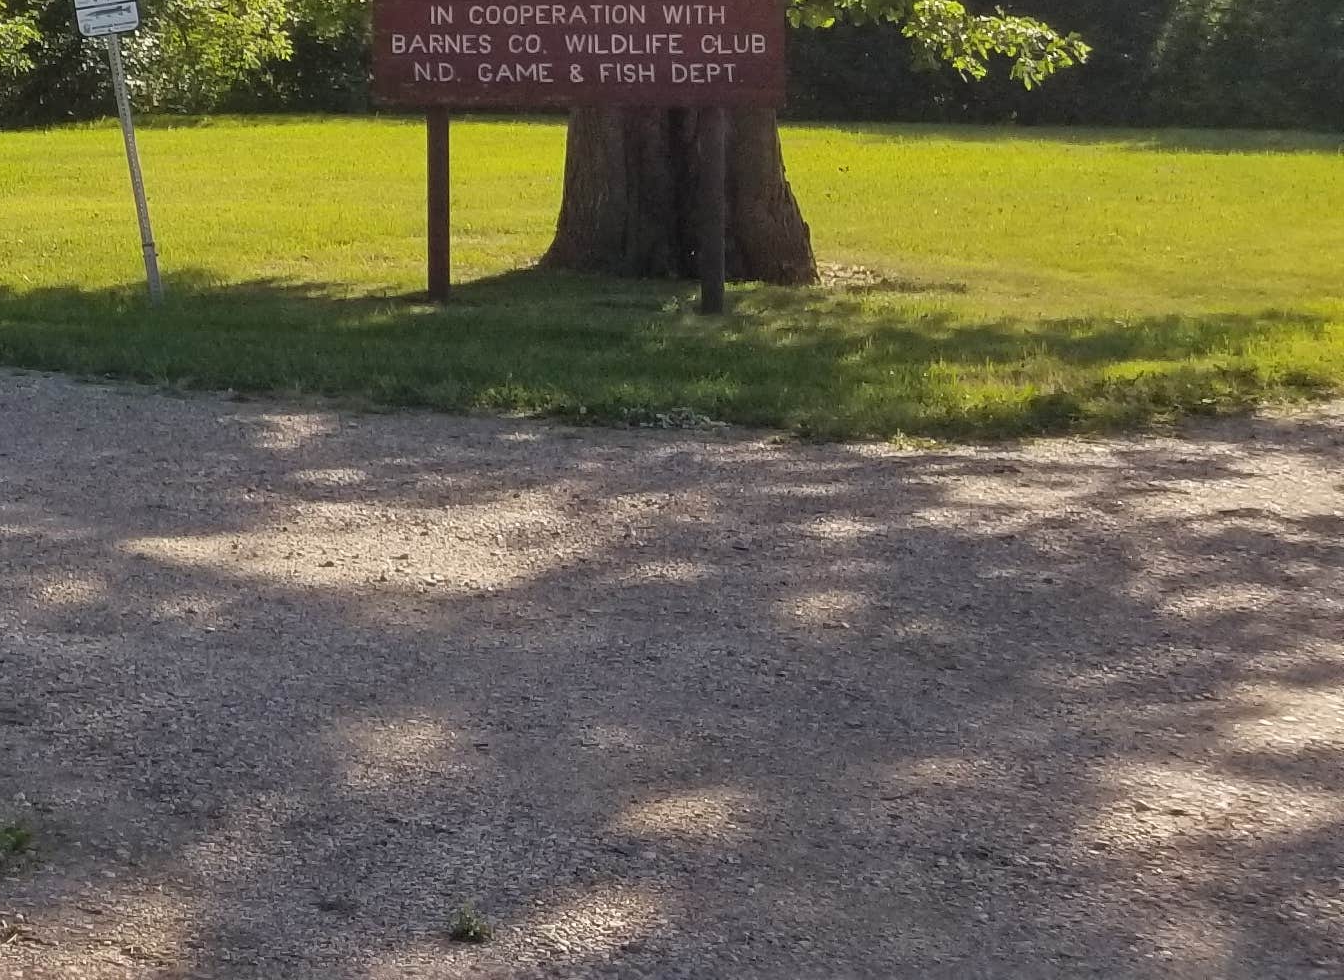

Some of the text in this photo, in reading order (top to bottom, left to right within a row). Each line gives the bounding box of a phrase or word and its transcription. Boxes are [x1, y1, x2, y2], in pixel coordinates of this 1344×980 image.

[430, 5, 726, 26] IN COOPERATION WITH
[391, 34, 766, 55] BARNES CO. WILDLIFE CLUB
[414, 62, 461, 82] N.D.
[478, 63, 554, 83] GAME
[569, 64, 585, 83] &
[600, 63, 655, 83] FISH
